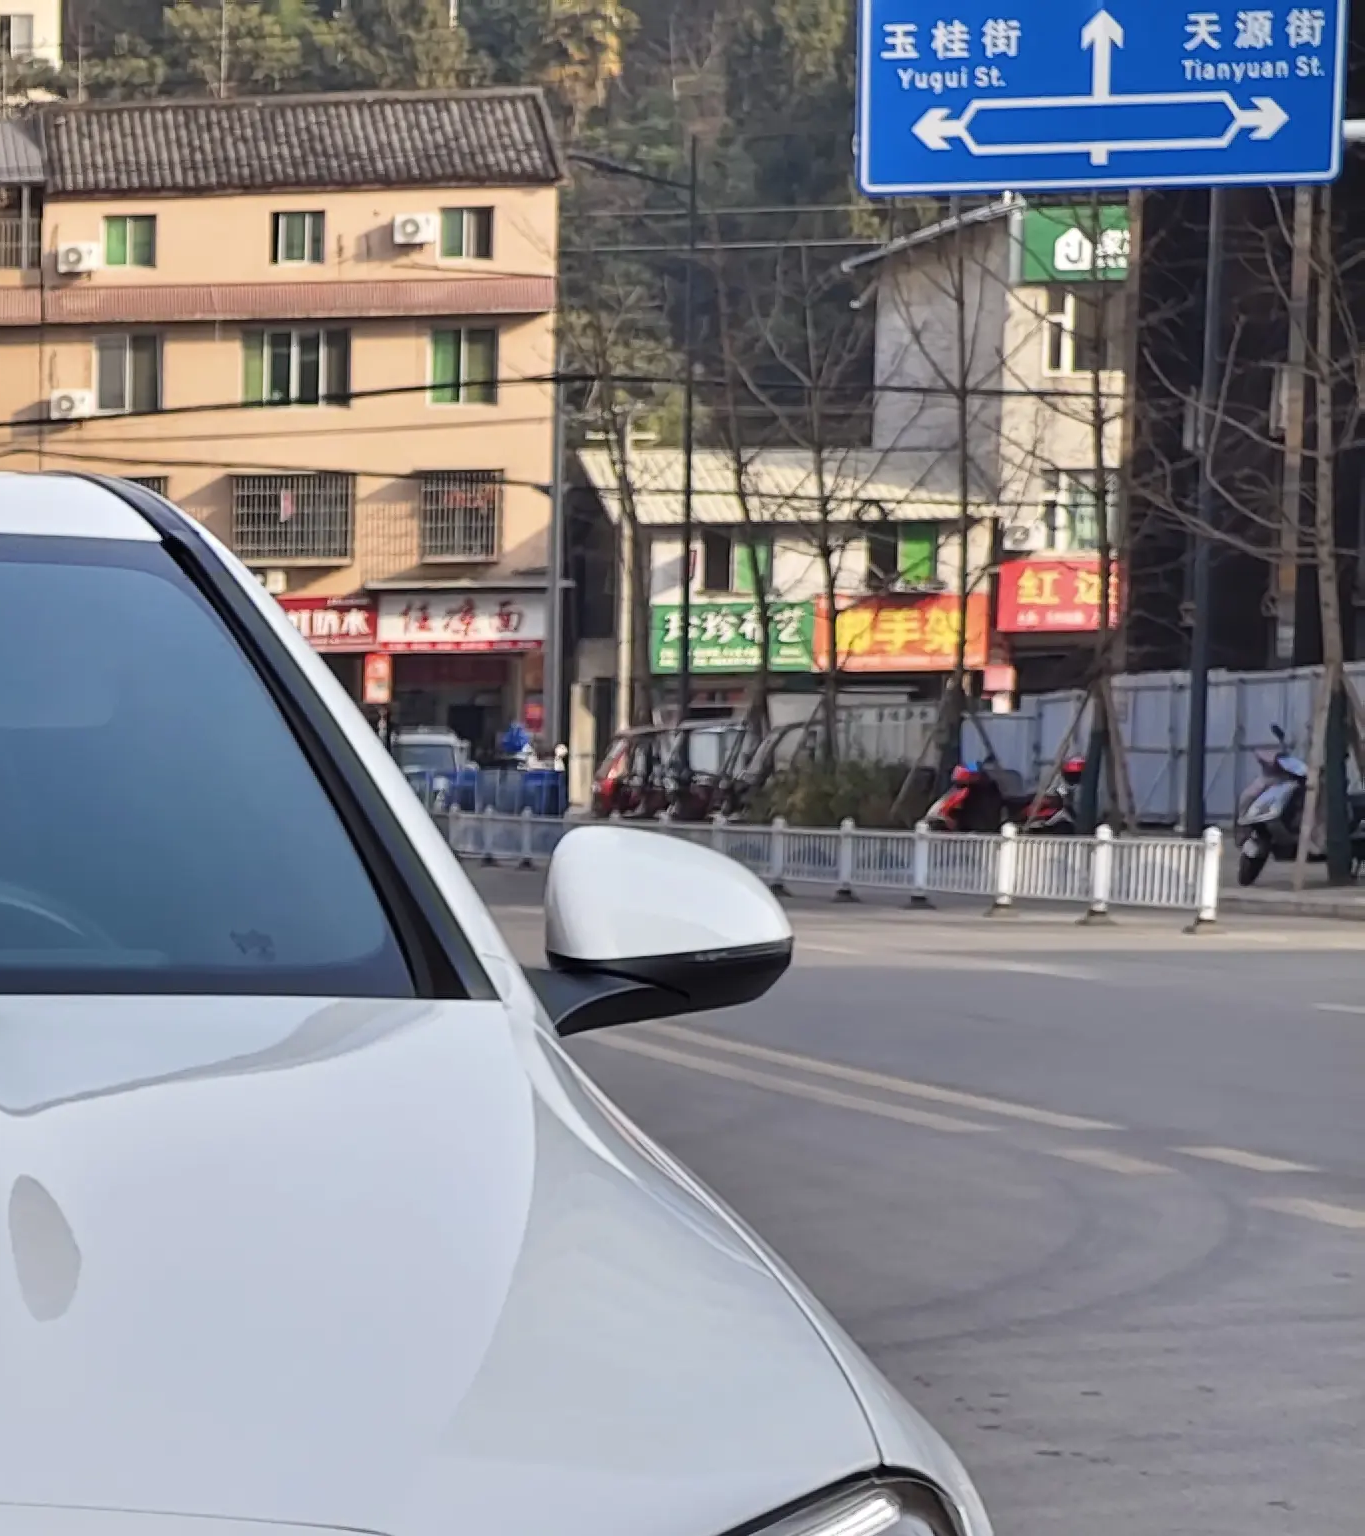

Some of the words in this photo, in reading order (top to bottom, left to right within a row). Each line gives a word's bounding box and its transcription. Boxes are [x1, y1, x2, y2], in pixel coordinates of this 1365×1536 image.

[880, 18, 1022, 60] 玉桂街
[1183, 8, 1326, 51] 天源街
[974, 66, 1007, 88] St.
[1181, 58, 1289, 84] Tianyuan
[1295, 54, 1326, 78] St.
